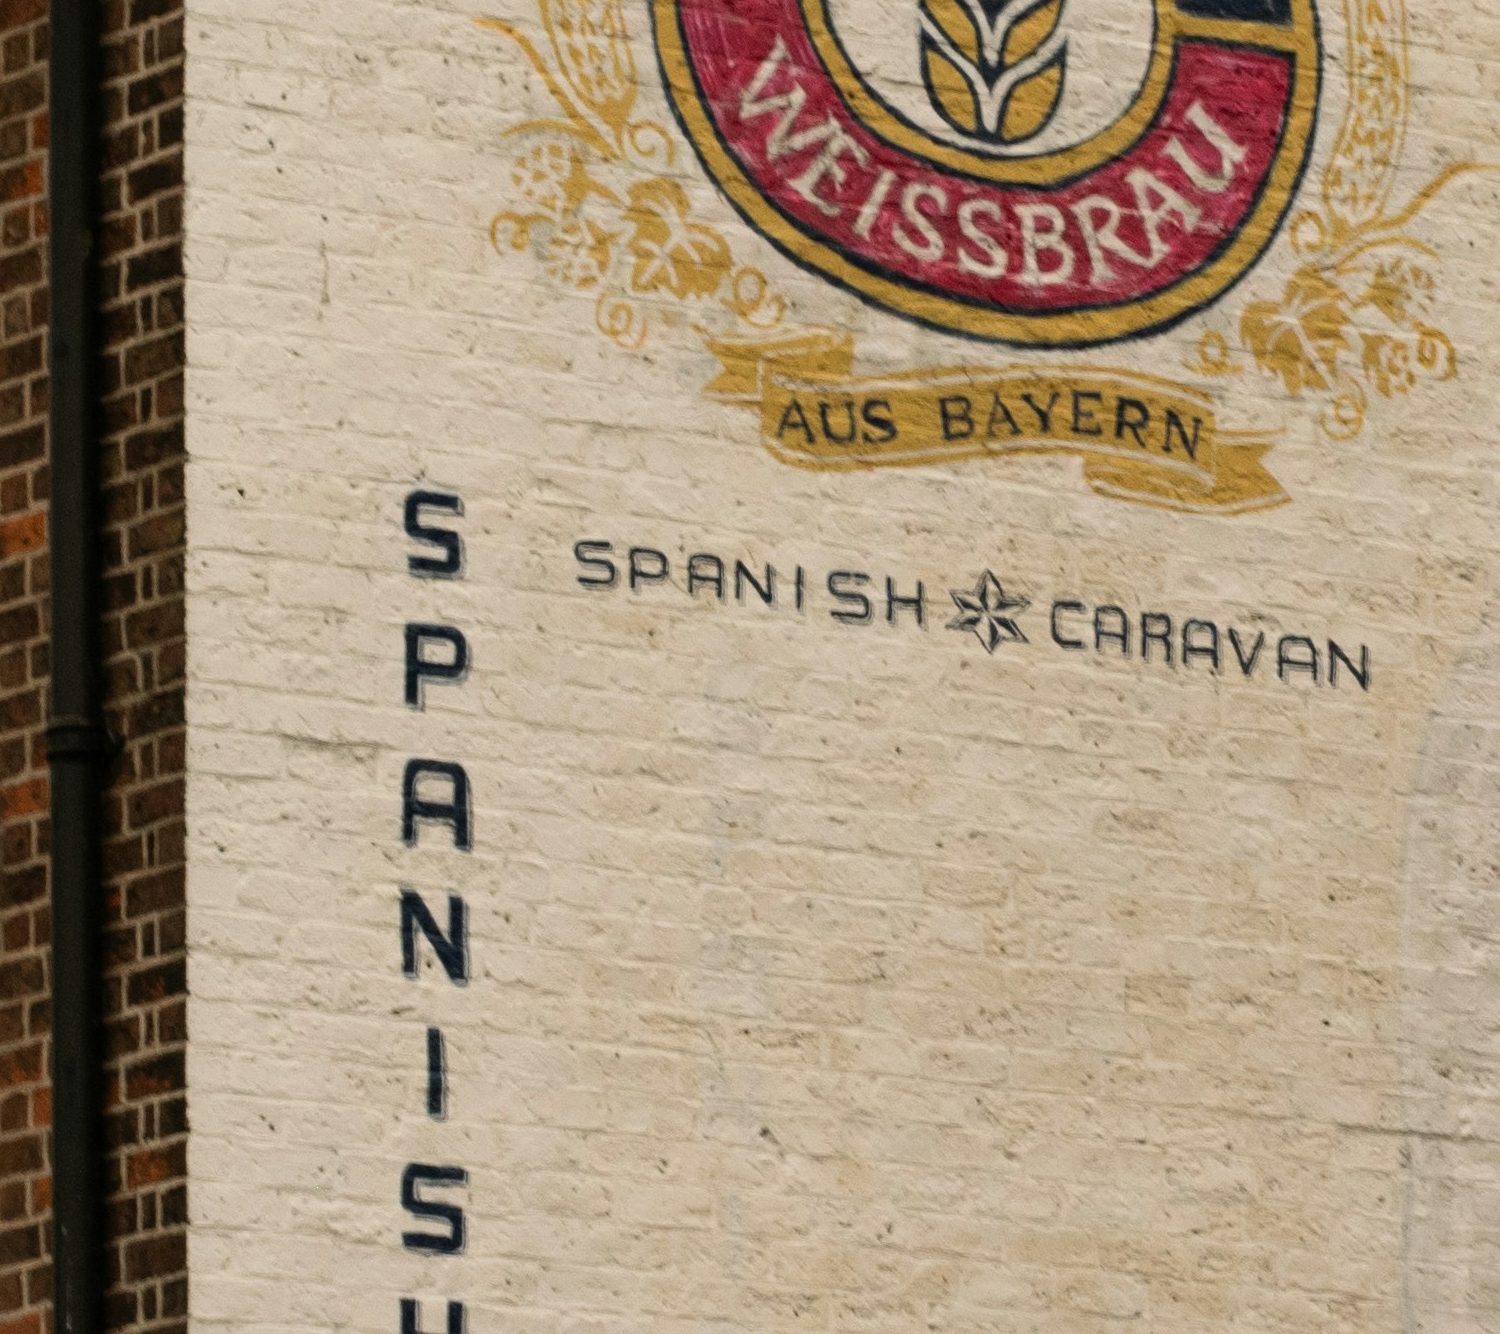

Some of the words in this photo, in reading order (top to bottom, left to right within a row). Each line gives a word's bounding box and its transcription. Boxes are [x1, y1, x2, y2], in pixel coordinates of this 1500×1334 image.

[738, 34, 1248, 285] WEISSBRAU
[777, 397, 897, 444] AUS
[938, 390, 1203, 459] BAYERN
[575, 541, 925, 627] SPANISH
[1050, 600, 1372, 690] CARAVAN
